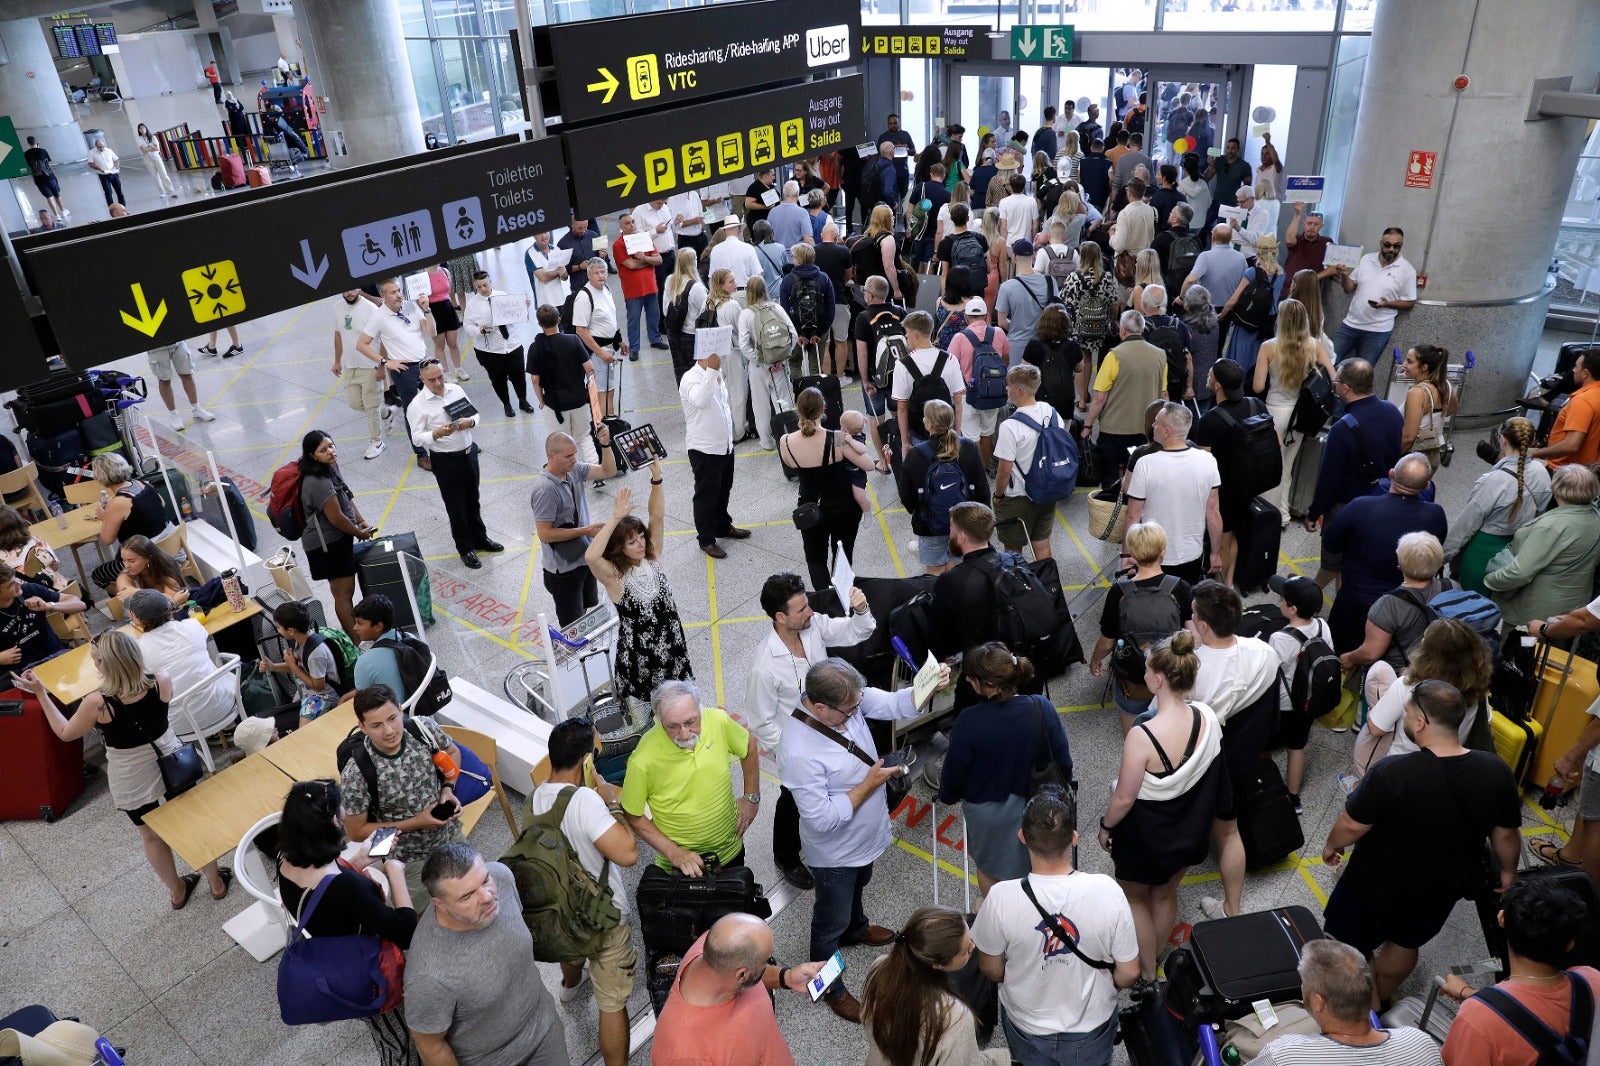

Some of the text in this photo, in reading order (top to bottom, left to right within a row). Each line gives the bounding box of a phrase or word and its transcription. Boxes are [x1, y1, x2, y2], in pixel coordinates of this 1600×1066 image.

[783, 33, 800, 48] APP
[944, 28, 973, 37] Ausgang
[944, 37, 957, 46] Way
[810, 35, 846, 58] Uber
[944, 46, 965, 55] Salida
[668, 69, 697, 91] VTC
[809, 96, 843, 113] Ausgang
[809, 112, 841, 130] Way out
[754, 127, 770, 138] TAXI
[810, 130, 841, 149] Salida
[487, 163, 543, 188] Toiletten
[652, 157, 668, 186] P
[490, 188, 534, 209] Toilets
[497, 208, 545, 235] Aseos
[430, 570, 467, 600] THIS
[455, 592, 520, 628] AREA
[436, 688, 452, 702] FILA
